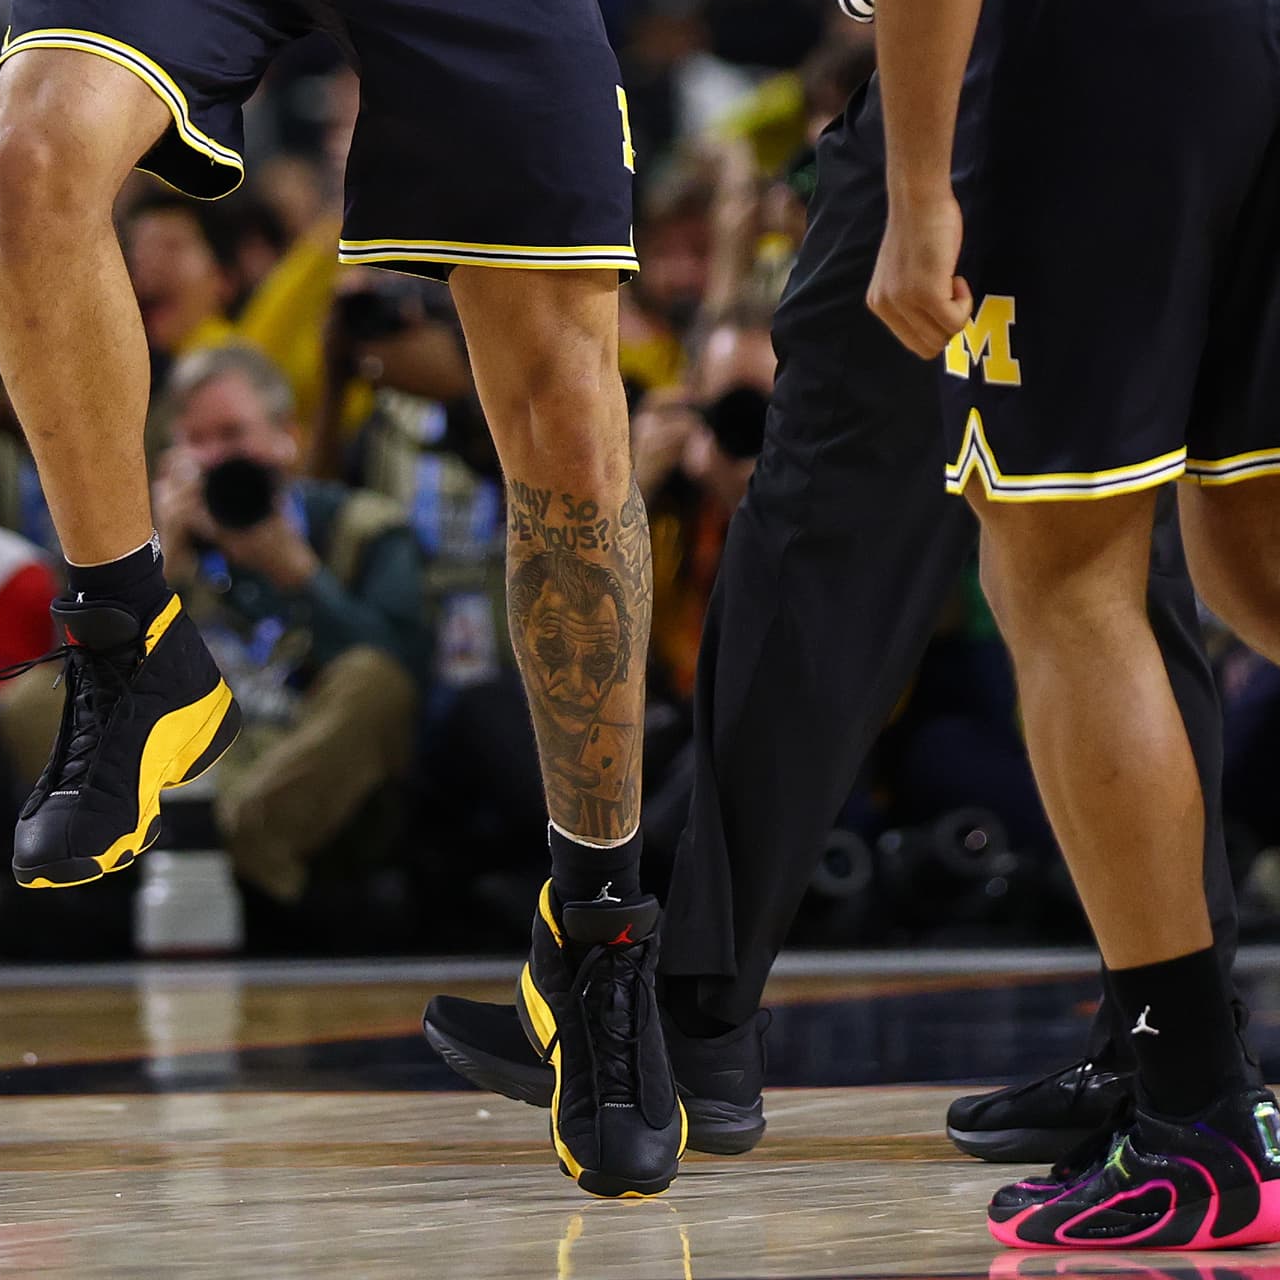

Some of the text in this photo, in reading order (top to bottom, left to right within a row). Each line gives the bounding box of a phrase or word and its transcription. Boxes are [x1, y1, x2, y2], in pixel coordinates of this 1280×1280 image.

[944, 293, 1022, 386] M
[511, 479, 598, 521] WHY SO
